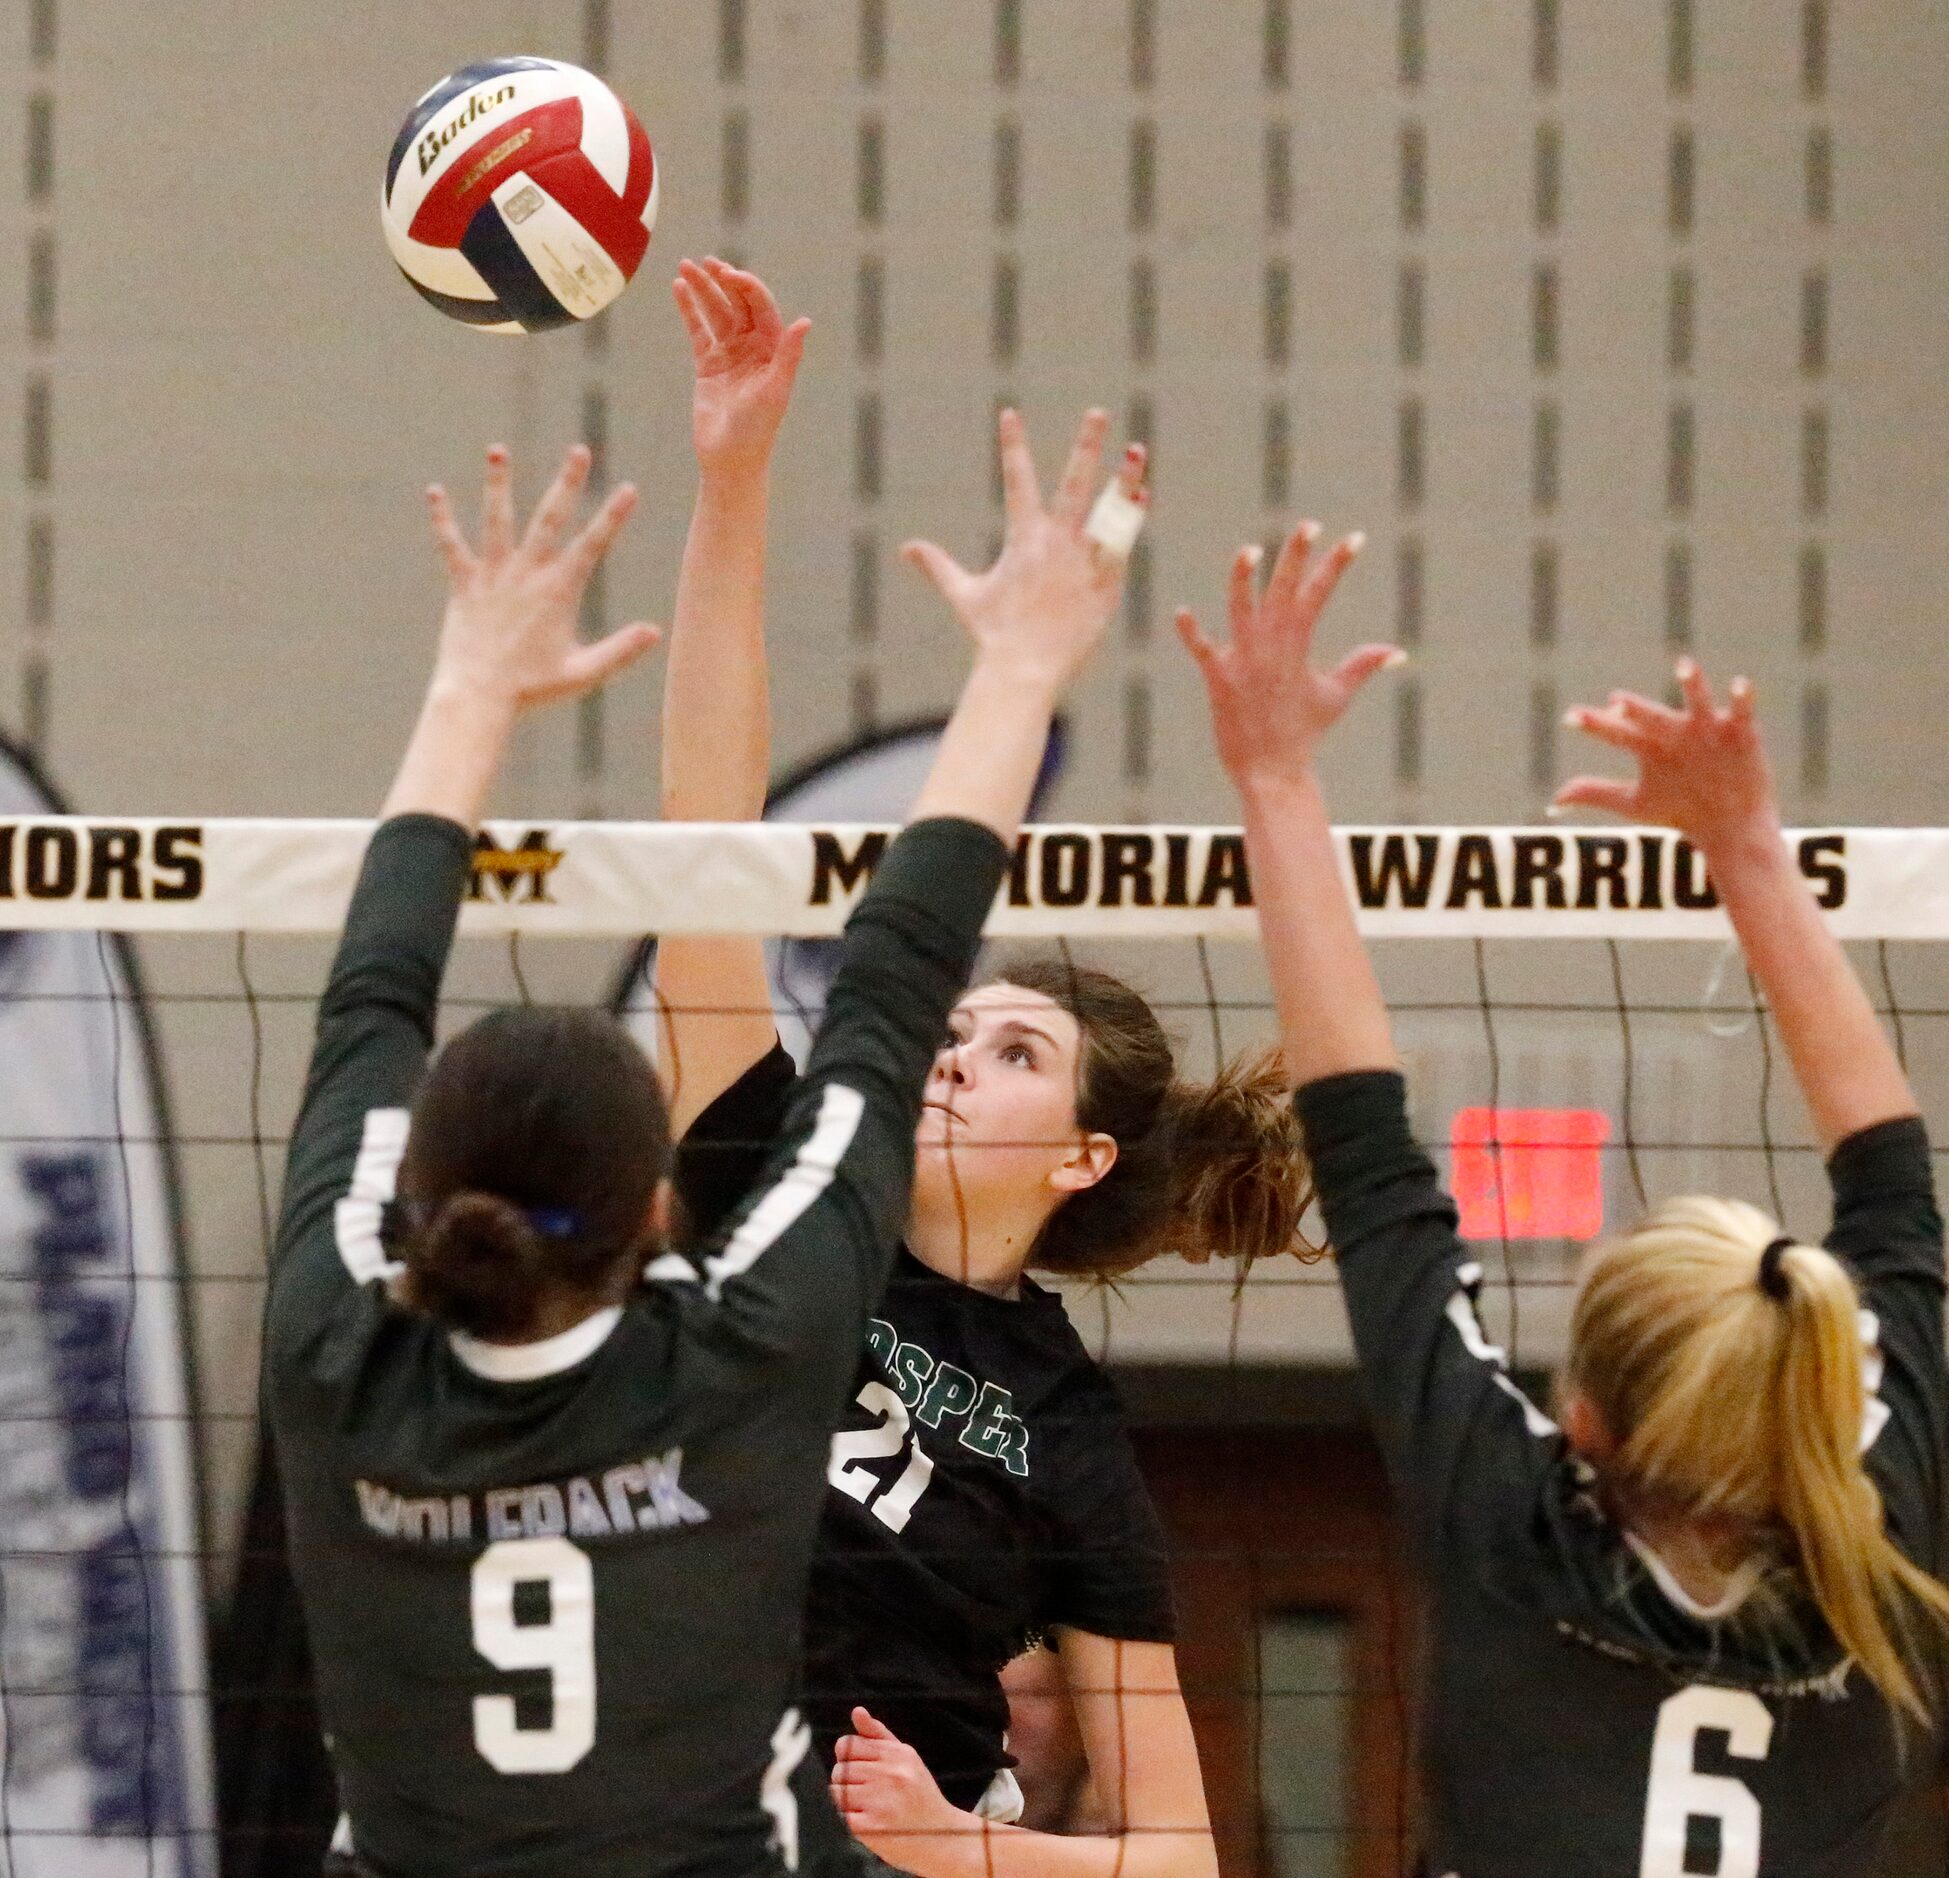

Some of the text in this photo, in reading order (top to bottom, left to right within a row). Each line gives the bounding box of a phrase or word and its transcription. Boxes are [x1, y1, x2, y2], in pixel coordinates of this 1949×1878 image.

[417, 85, 515, 177] Baden
[810, 832, 1847, 909] MORIA WARRIOS
[826, 1380, 935, 1535] 21
[471, 1535, 597, 1774] 9
[1639, 1684, 1775, 1878] 6
